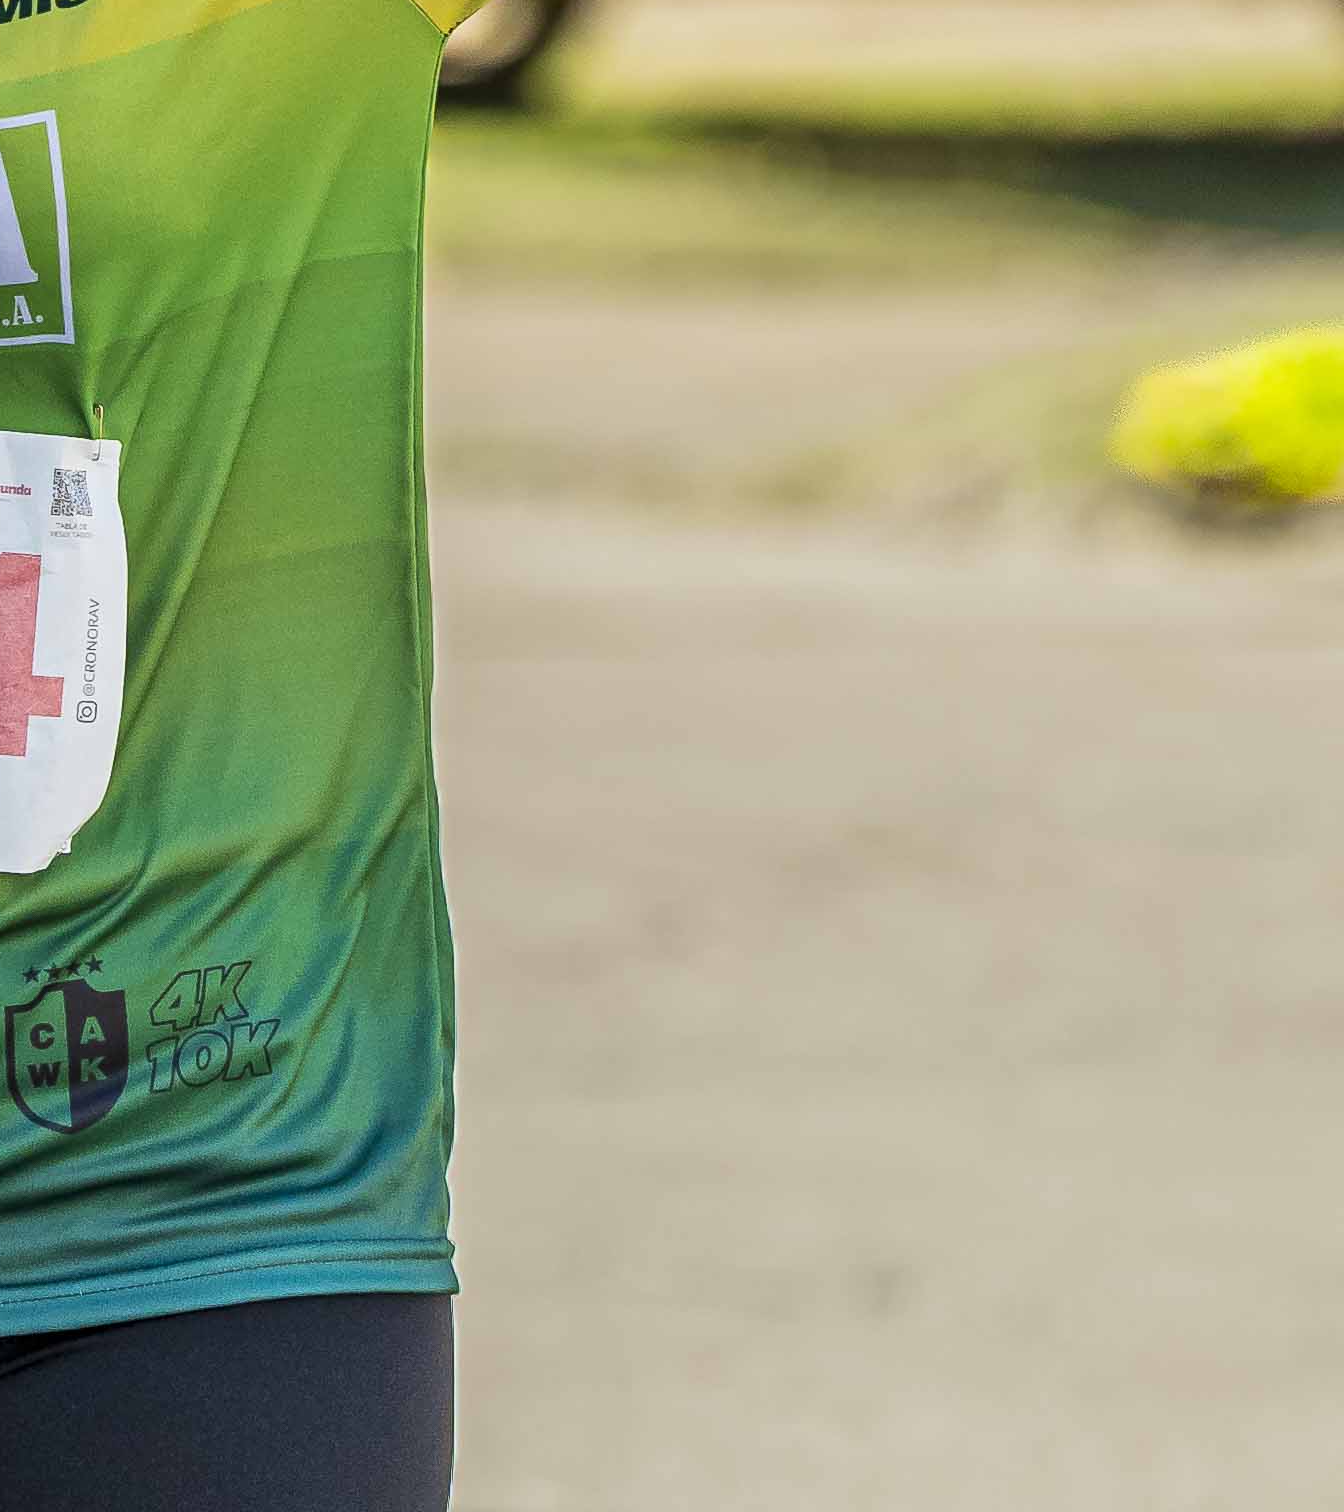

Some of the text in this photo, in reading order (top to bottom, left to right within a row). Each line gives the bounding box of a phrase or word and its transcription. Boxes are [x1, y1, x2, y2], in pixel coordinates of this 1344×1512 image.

[82, 598, 100, 697] @CRONORAV
[149, 960, 253, 1032] 4K
[146, 1018, 281, 1093] 10K
